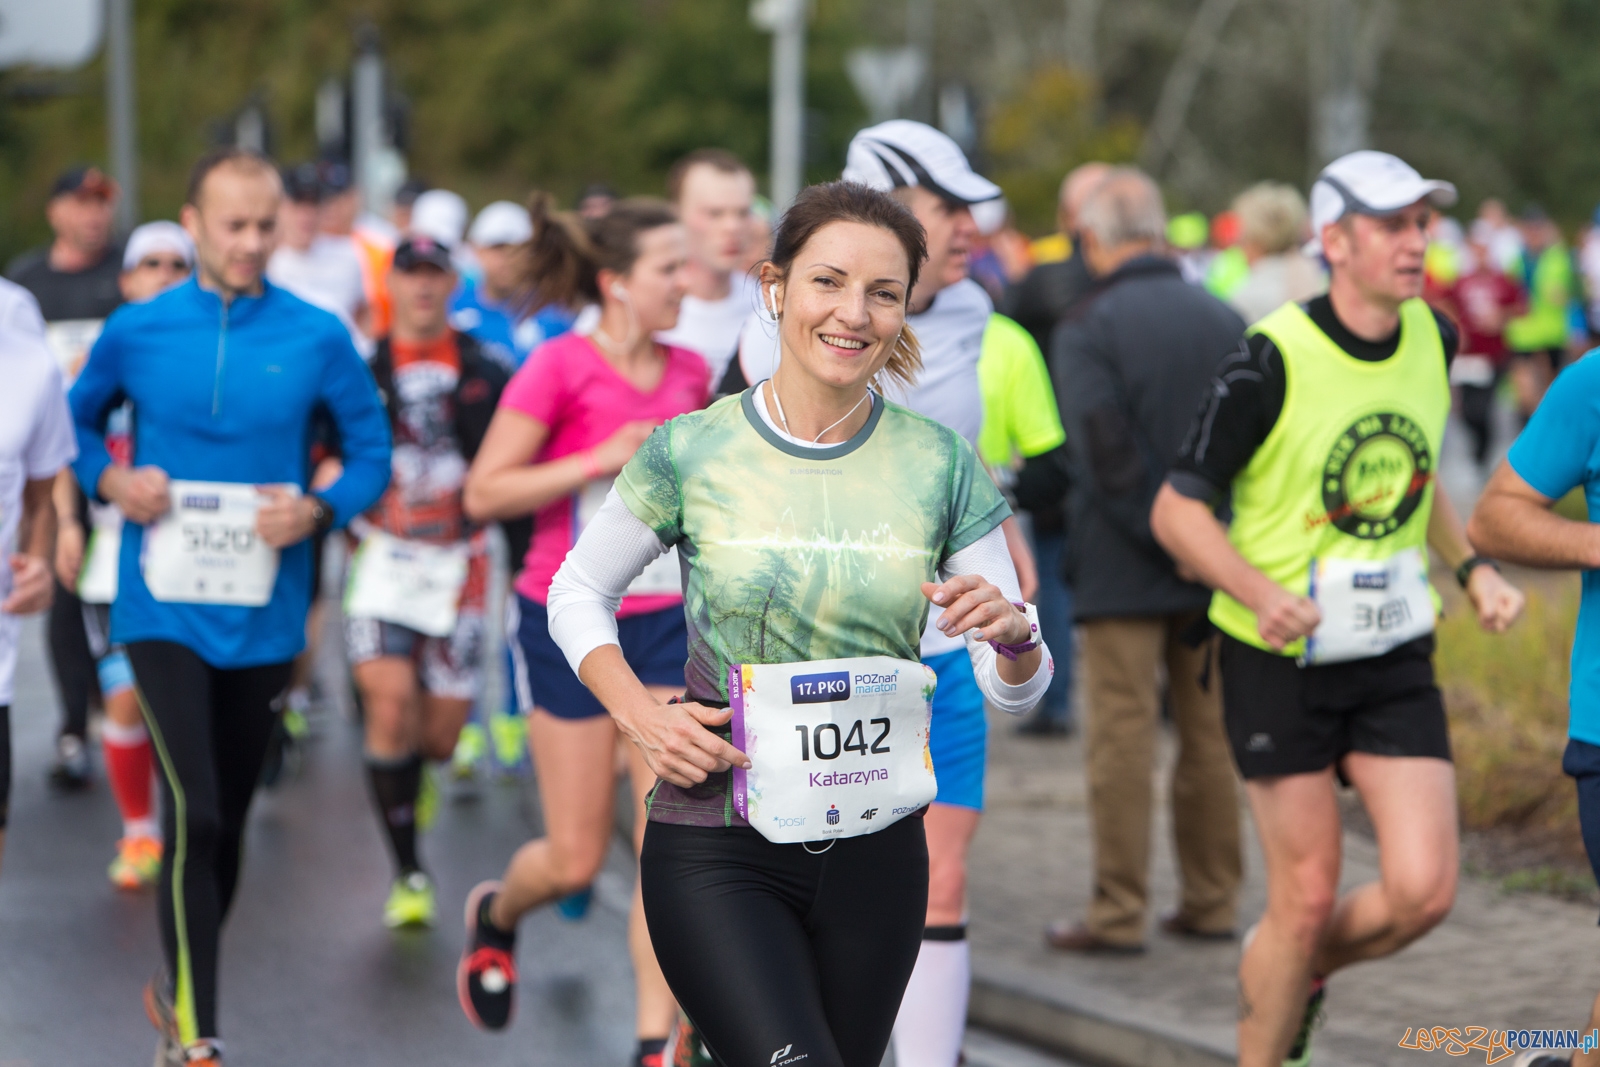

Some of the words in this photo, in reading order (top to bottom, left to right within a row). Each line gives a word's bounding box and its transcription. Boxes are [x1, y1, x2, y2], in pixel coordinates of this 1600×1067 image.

[796, 683, 816, 696] 17.
[818, 679, 847, 695] PKO
[855, 682, 897, 694] maraton
[795, 717, 891, 761] 1042
[808, 768, 889, 791] Katarzyna
[860, 808, 879, 820] 4F
[778, 1053, 808, 1067] TOUCH
